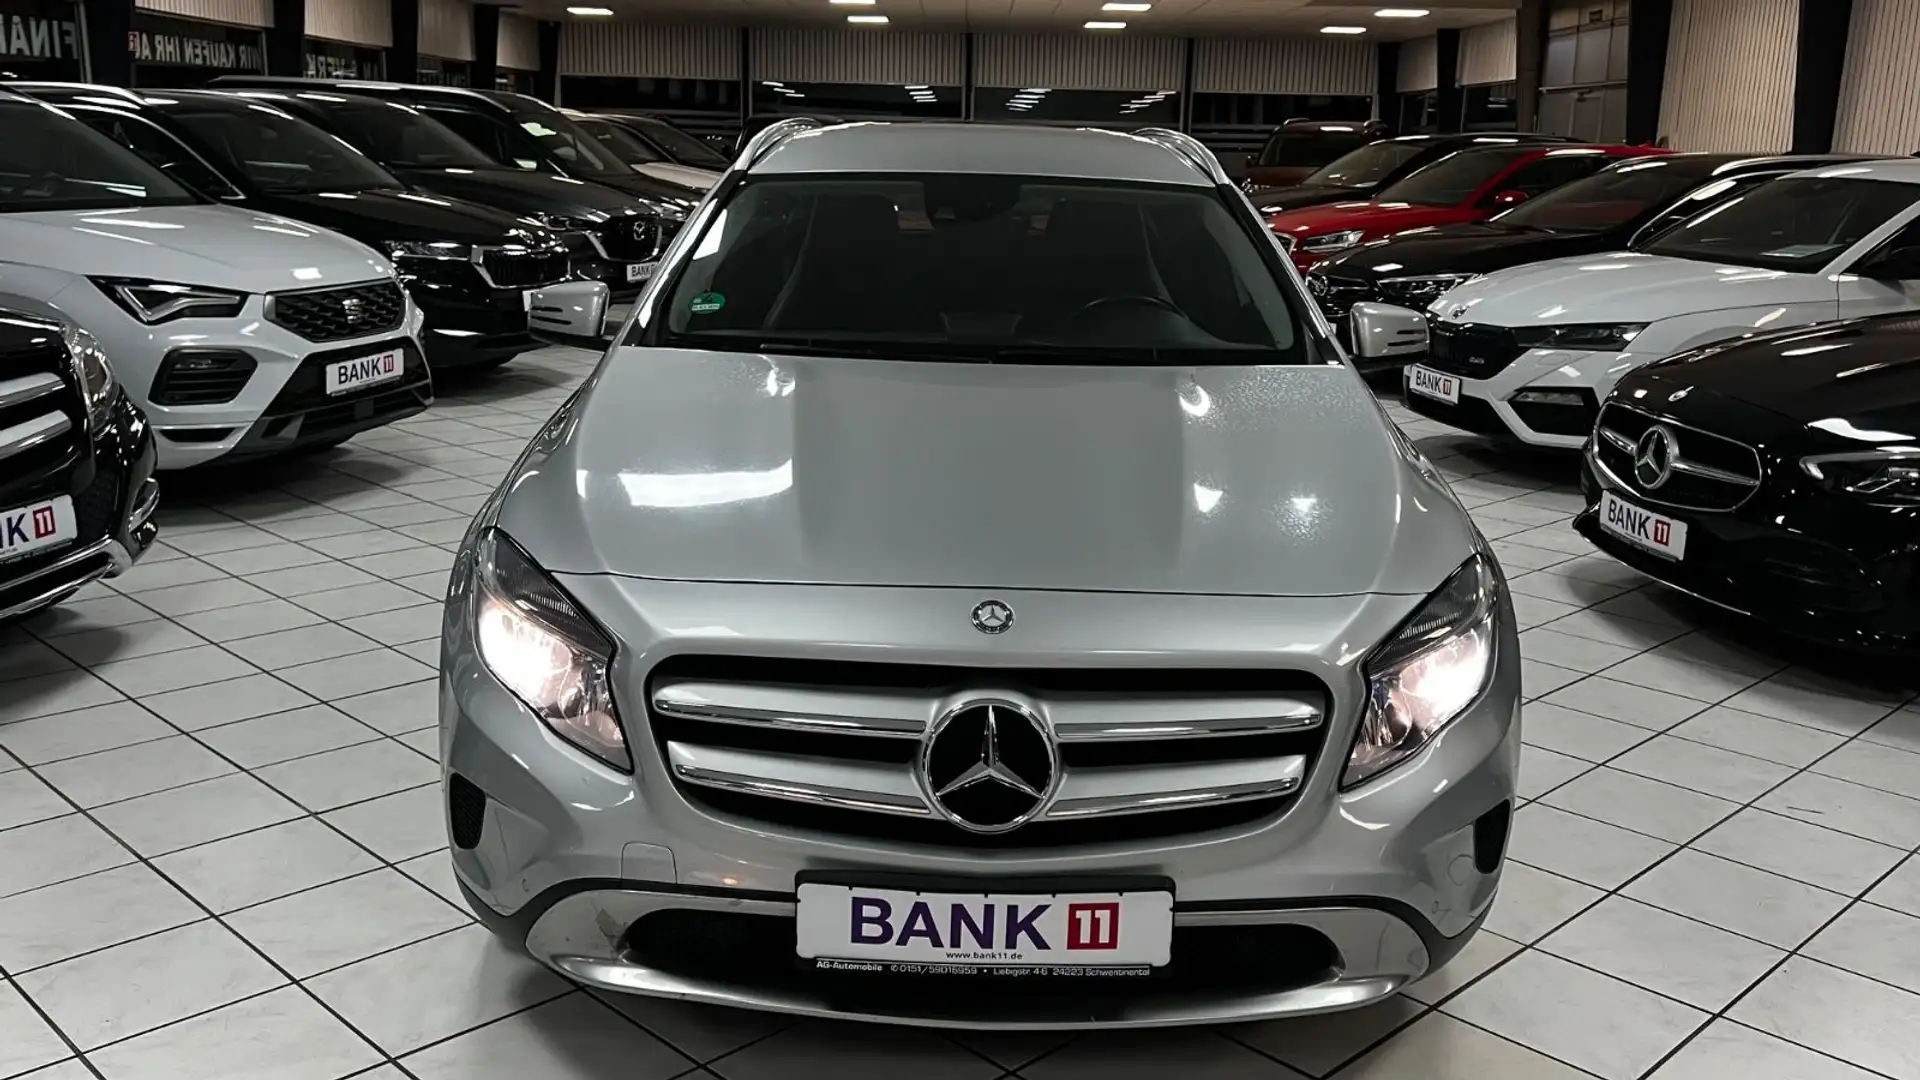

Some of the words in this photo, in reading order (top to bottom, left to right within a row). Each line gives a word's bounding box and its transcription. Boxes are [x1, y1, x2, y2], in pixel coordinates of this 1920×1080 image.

[338, 357, 381, 385] BANK
[1416, 370, 1442, 393] BANK
[35, 509, 54, 536] 11
[1608, 500, 1651, 540] BANK
[1656, 521, 1670, 544] 11
[850, 896, 1052, 950] BANK
[1074, 908, 1111, 945] 11
[816, 960, 883, 971] AG-Automobile
[946, 951, 1023, 960] www.bank11.de
